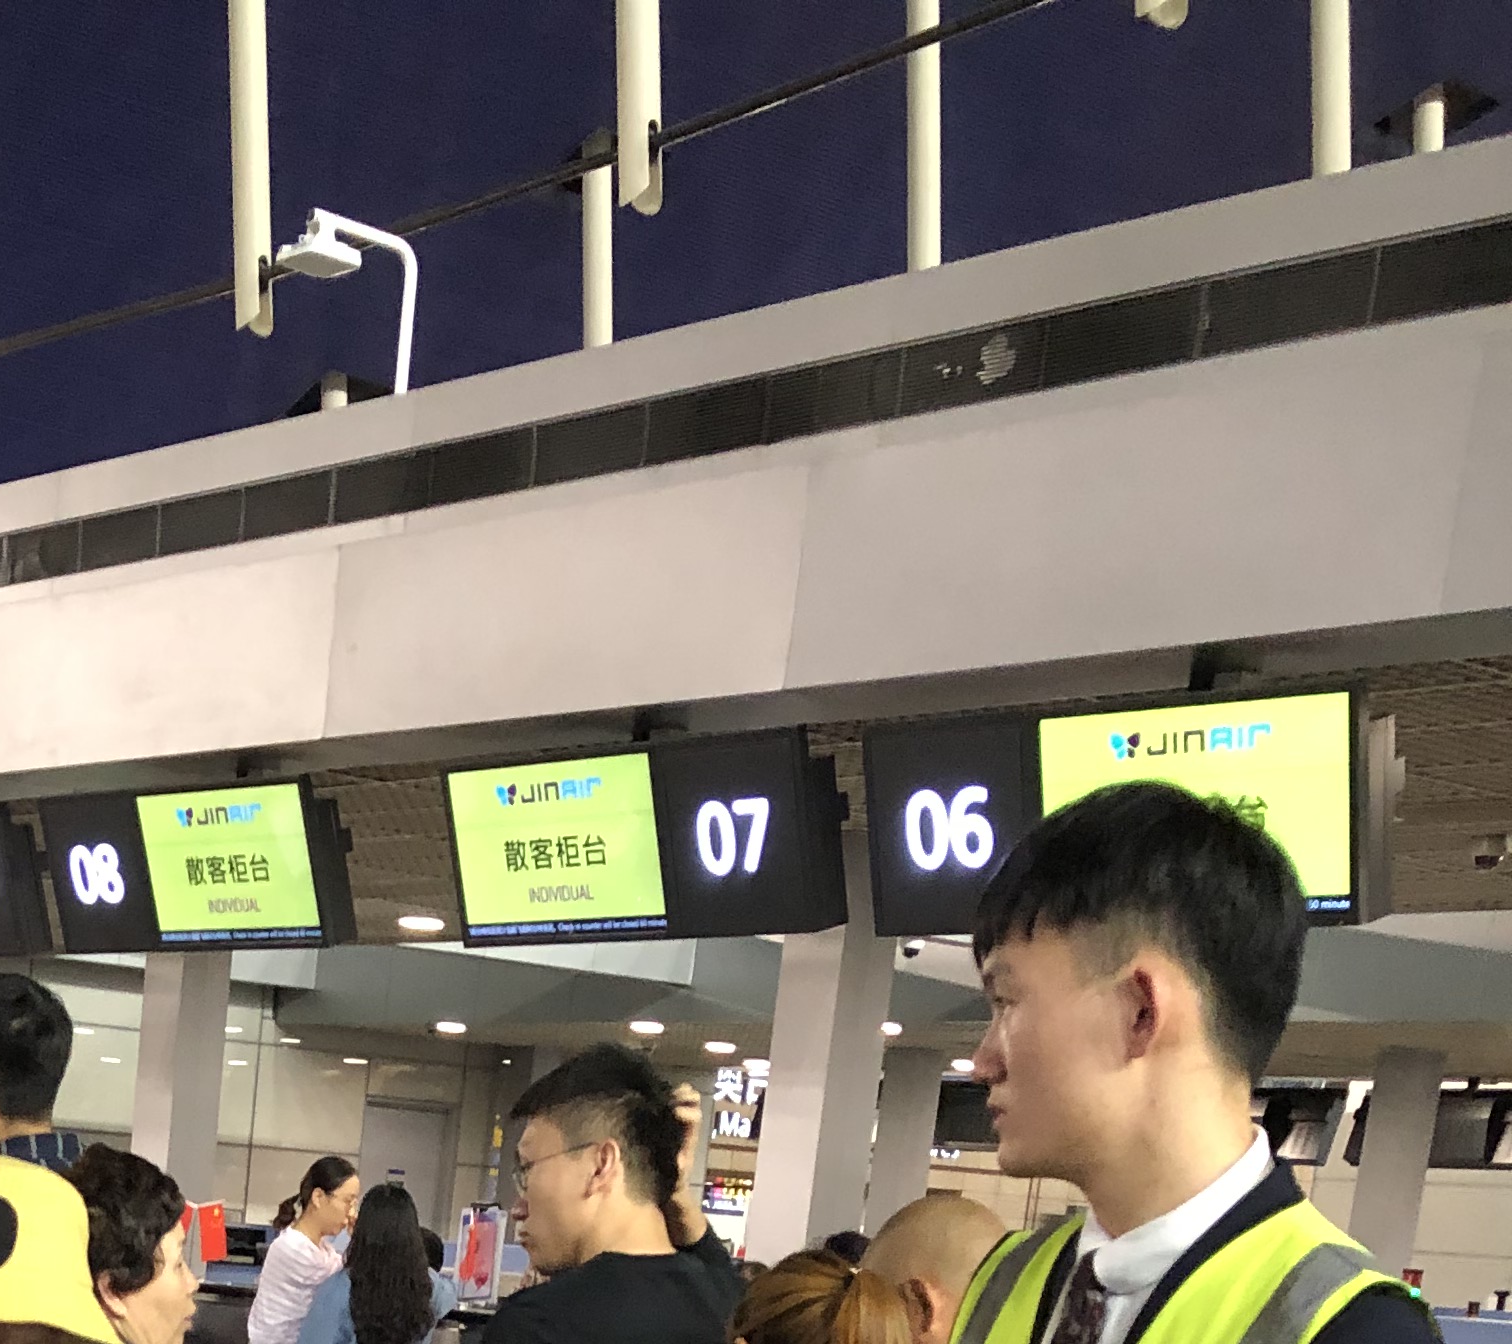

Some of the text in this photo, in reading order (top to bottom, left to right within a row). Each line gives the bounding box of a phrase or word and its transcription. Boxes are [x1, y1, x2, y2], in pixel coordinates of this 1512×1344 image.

[504, 834, 607, 872] 散客柜台
[695, 797, 770, 876] 07
[905, 785, 994, 871] 06
[69, 842, 126, 904] 08
[185, 853, 270, 886] 散客柜台
[528, 884, 594, 903] INDIVIDUAL
